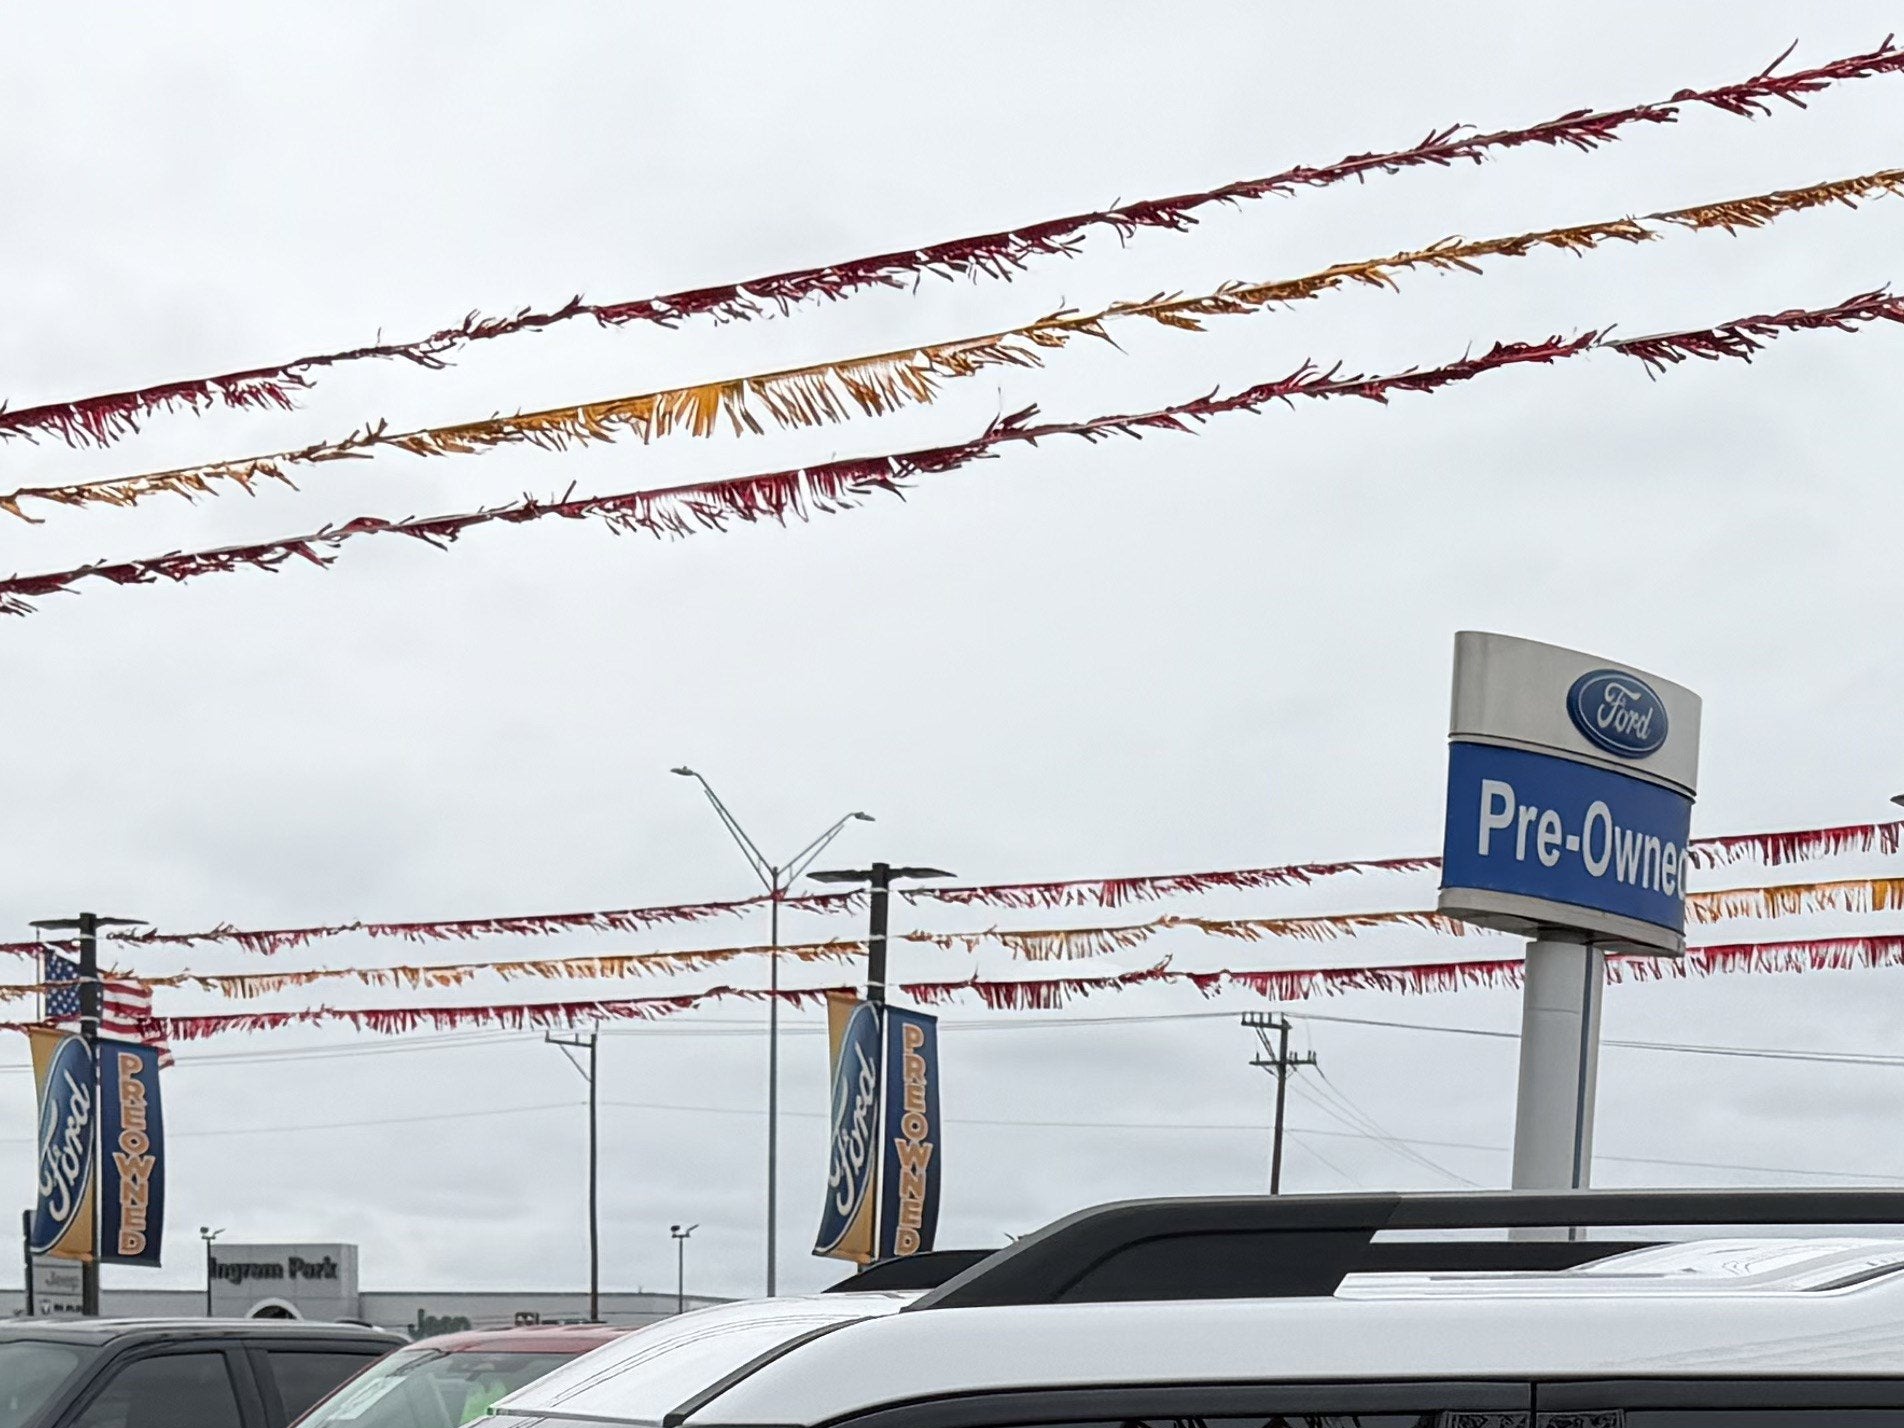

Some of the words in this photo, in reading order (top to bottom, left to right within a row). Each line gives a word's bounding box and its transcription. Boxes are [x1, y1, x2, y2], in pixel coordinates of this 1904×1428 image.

[1597, 682, 1652, 740] Ford
[39, 1069, 90, 1221] Ford
[112, 1052, 156, 1256] PREOWNED
[828, 1041, 876, 1217] Ford
[895, 1023, 933, 1256] PREOWNED
[210, 1256, 284, 1286] Ingram
[288, 1255, 338, 1280] Park
